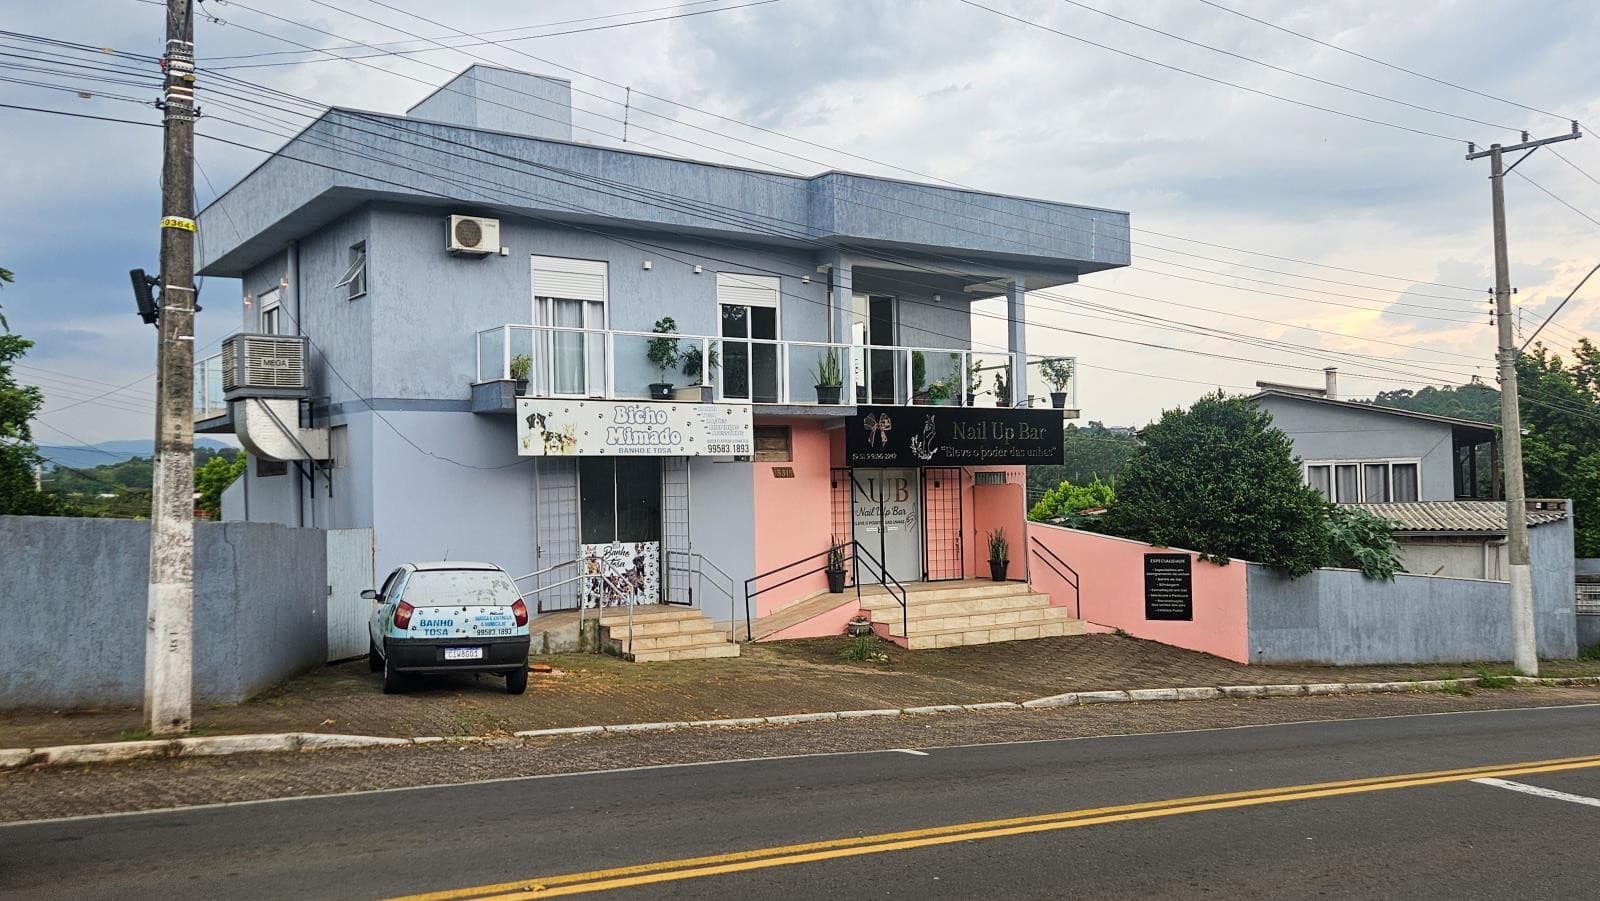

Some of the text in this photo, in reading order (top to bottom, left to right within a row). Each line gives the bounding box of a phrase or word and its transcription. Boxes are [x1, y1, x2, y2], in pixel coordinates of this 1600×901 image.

[263, 359, 287, 367] MEGA
[614, 405, 668, 424] Bicho
[606, 426, 681, 445] Mimado
[952, 421, 1048, 445] Nail Up Bar
[707, 443, 749, 453] 99583.1893
[980, 446, 1008, 460] poder
[853, 478, 909, 503] NUB
[857, 506, 875, 517] Nail
[891, 505, 907, 516] Bar
[420, 619, 453, 627] BANHO
[424, 628, 448, 636] TOSA
